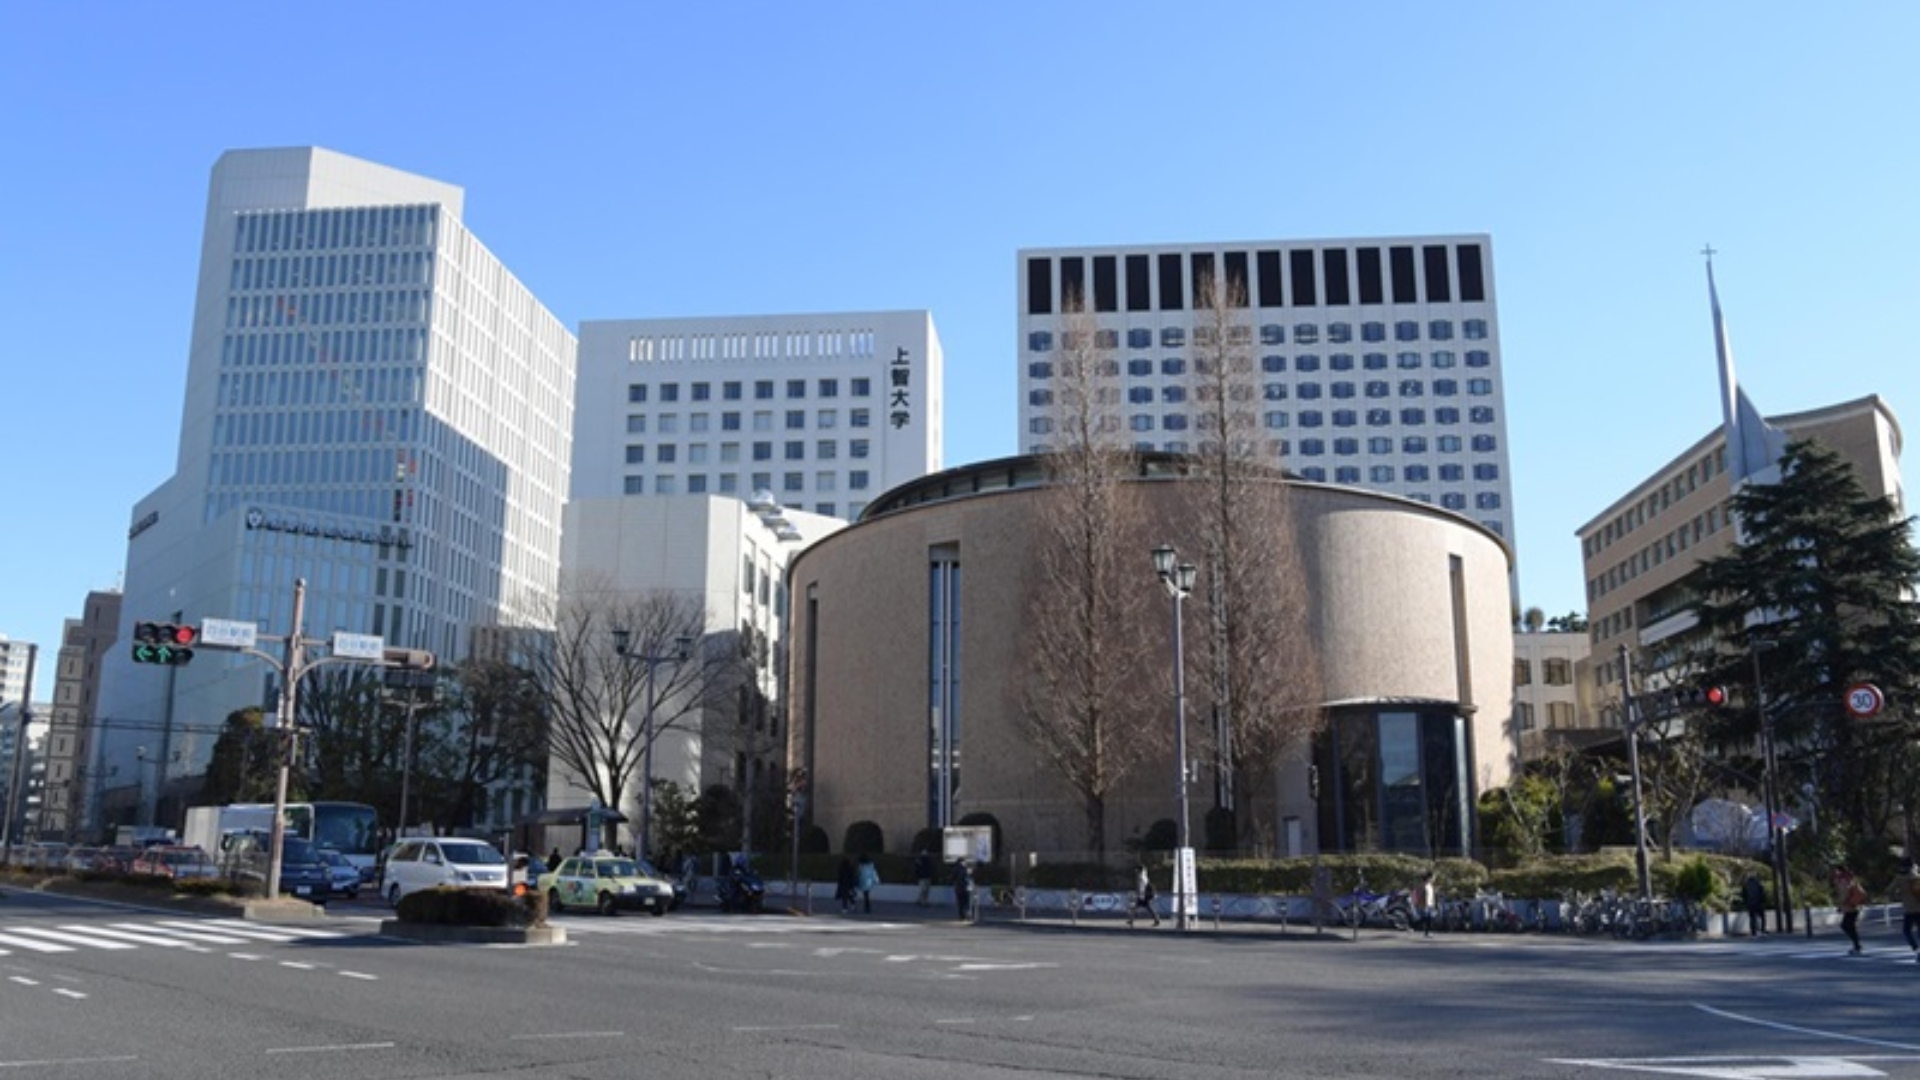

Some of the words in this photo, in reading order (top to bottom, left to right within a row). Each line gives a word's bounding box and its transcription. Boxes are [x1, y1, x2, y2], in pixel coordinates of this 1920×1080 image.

[890, 346, 910, 430] 上智大学
[1852, 693, 1873, 709] 30
